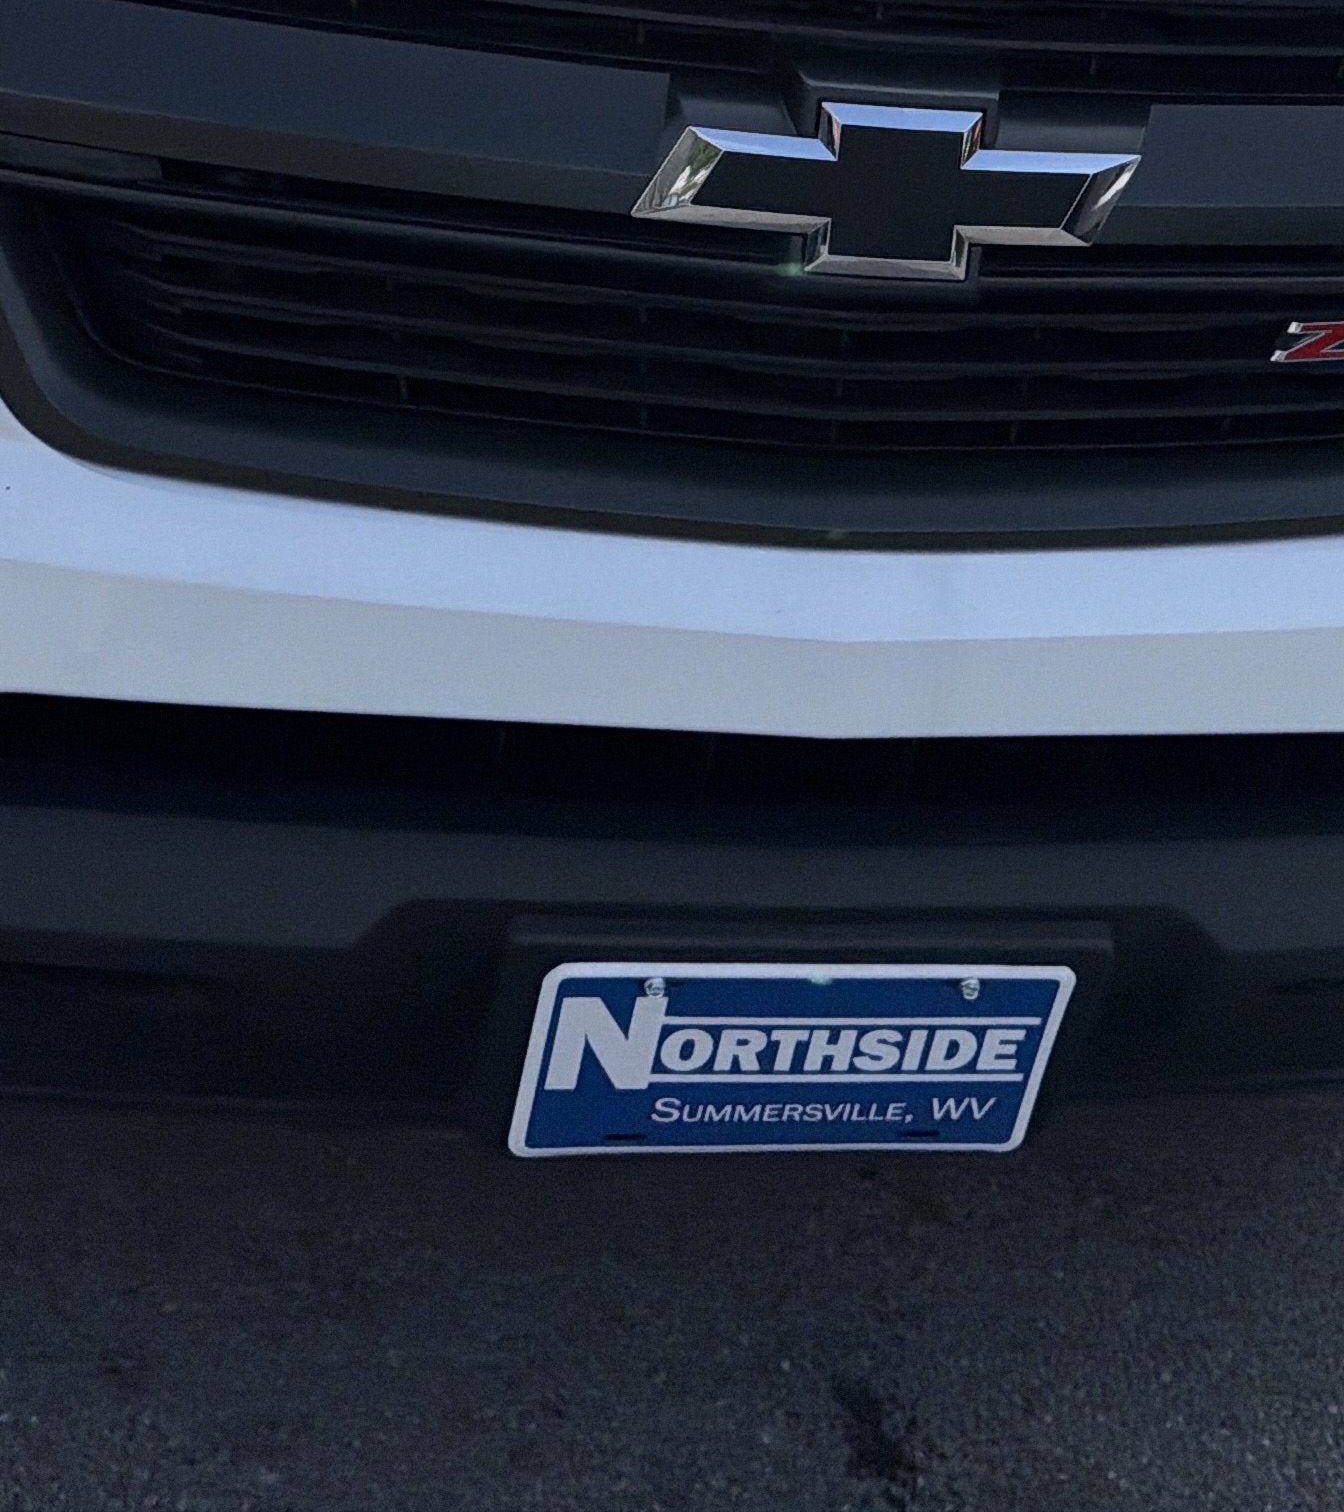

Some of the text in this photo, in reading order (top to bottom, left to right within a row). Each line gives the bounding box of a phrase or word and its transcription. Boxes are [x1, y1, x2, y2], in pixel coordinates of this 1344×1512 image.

[543, 996, 1026, 1091] NORTHSIDE
[650, 1096, 997, 1125] SUMMERSVILLE, WV
